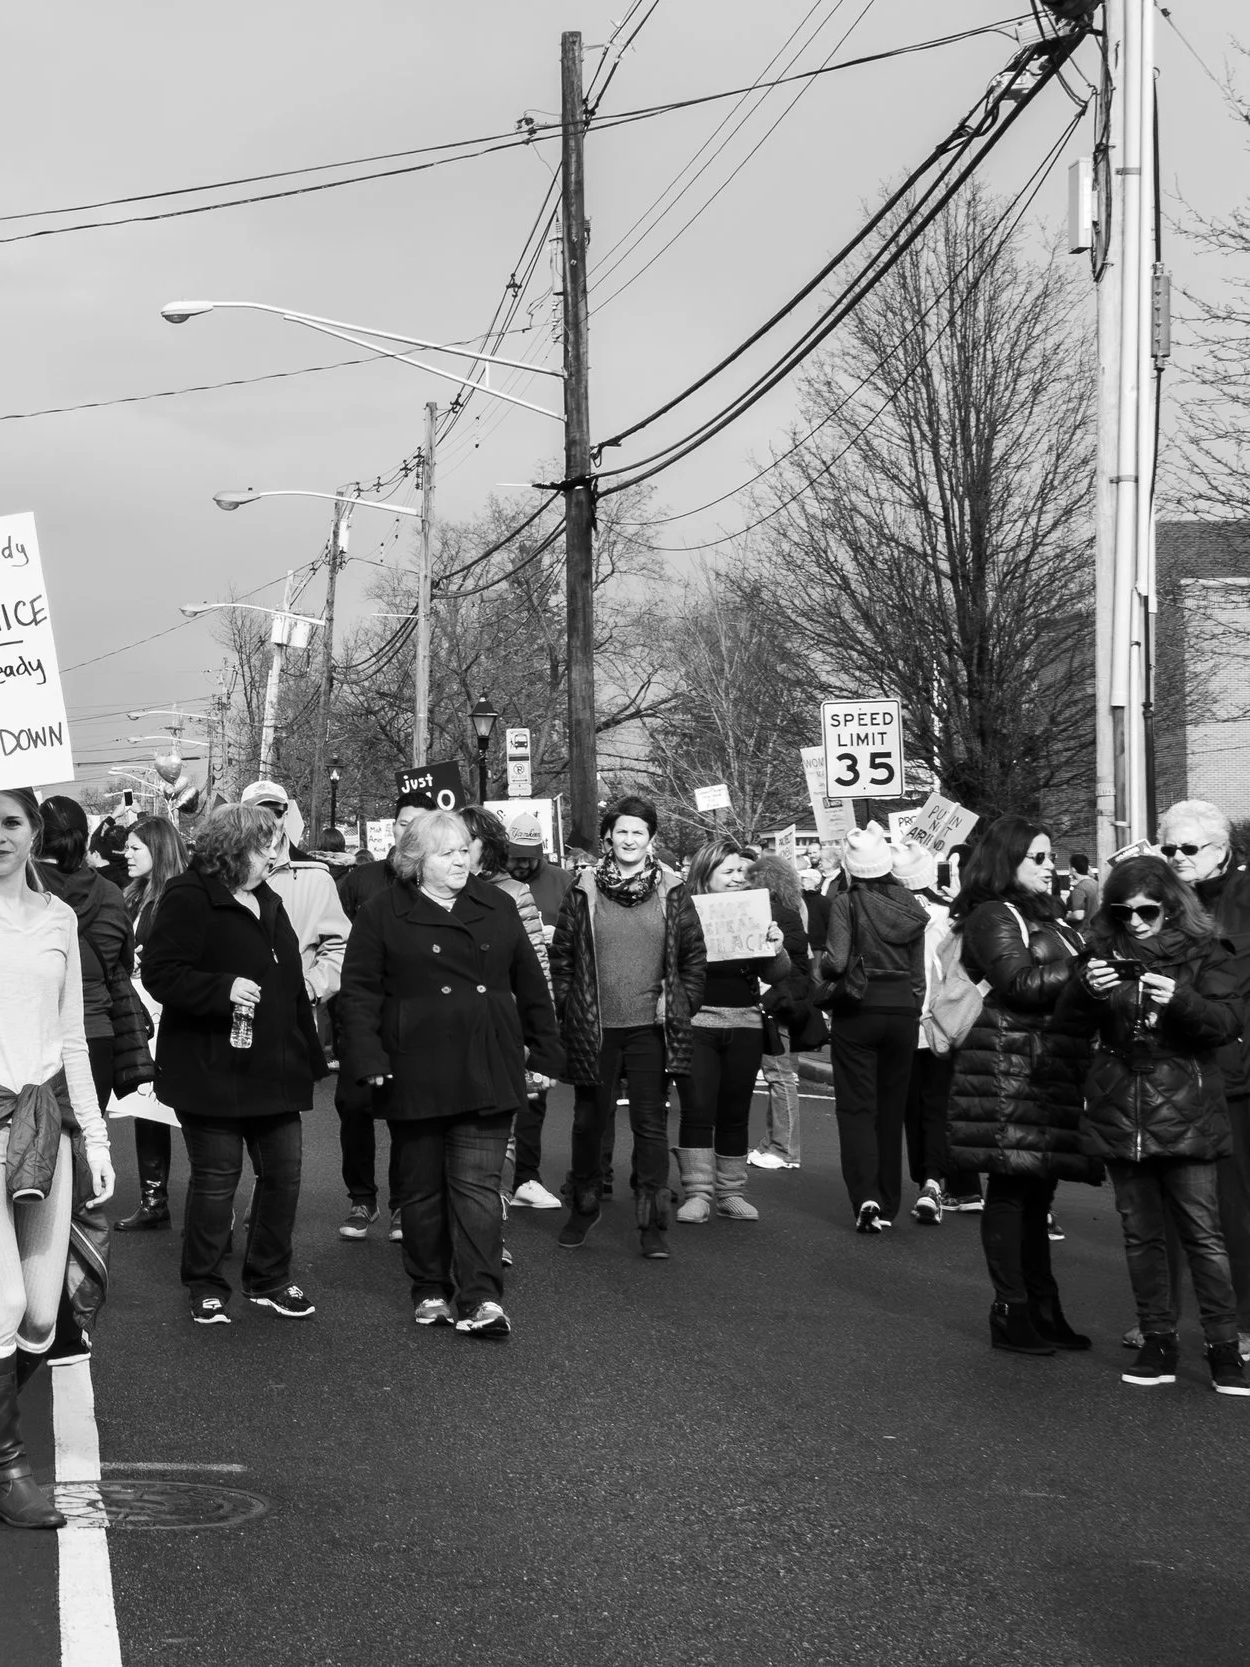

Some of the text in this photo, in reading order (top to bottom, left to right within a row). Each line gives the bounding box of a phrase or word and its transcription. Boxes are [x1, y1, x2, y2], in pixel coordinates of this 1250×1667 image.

[830, 712, 894, 728] SPEED
[0, 722, 63, 757] DOWN
[837, 732, 887, 747] LIMIT
[834, 751, 896, 787] 35
[401, 773, 433, 793] just
[928, 805, 963, 828] PUIN
